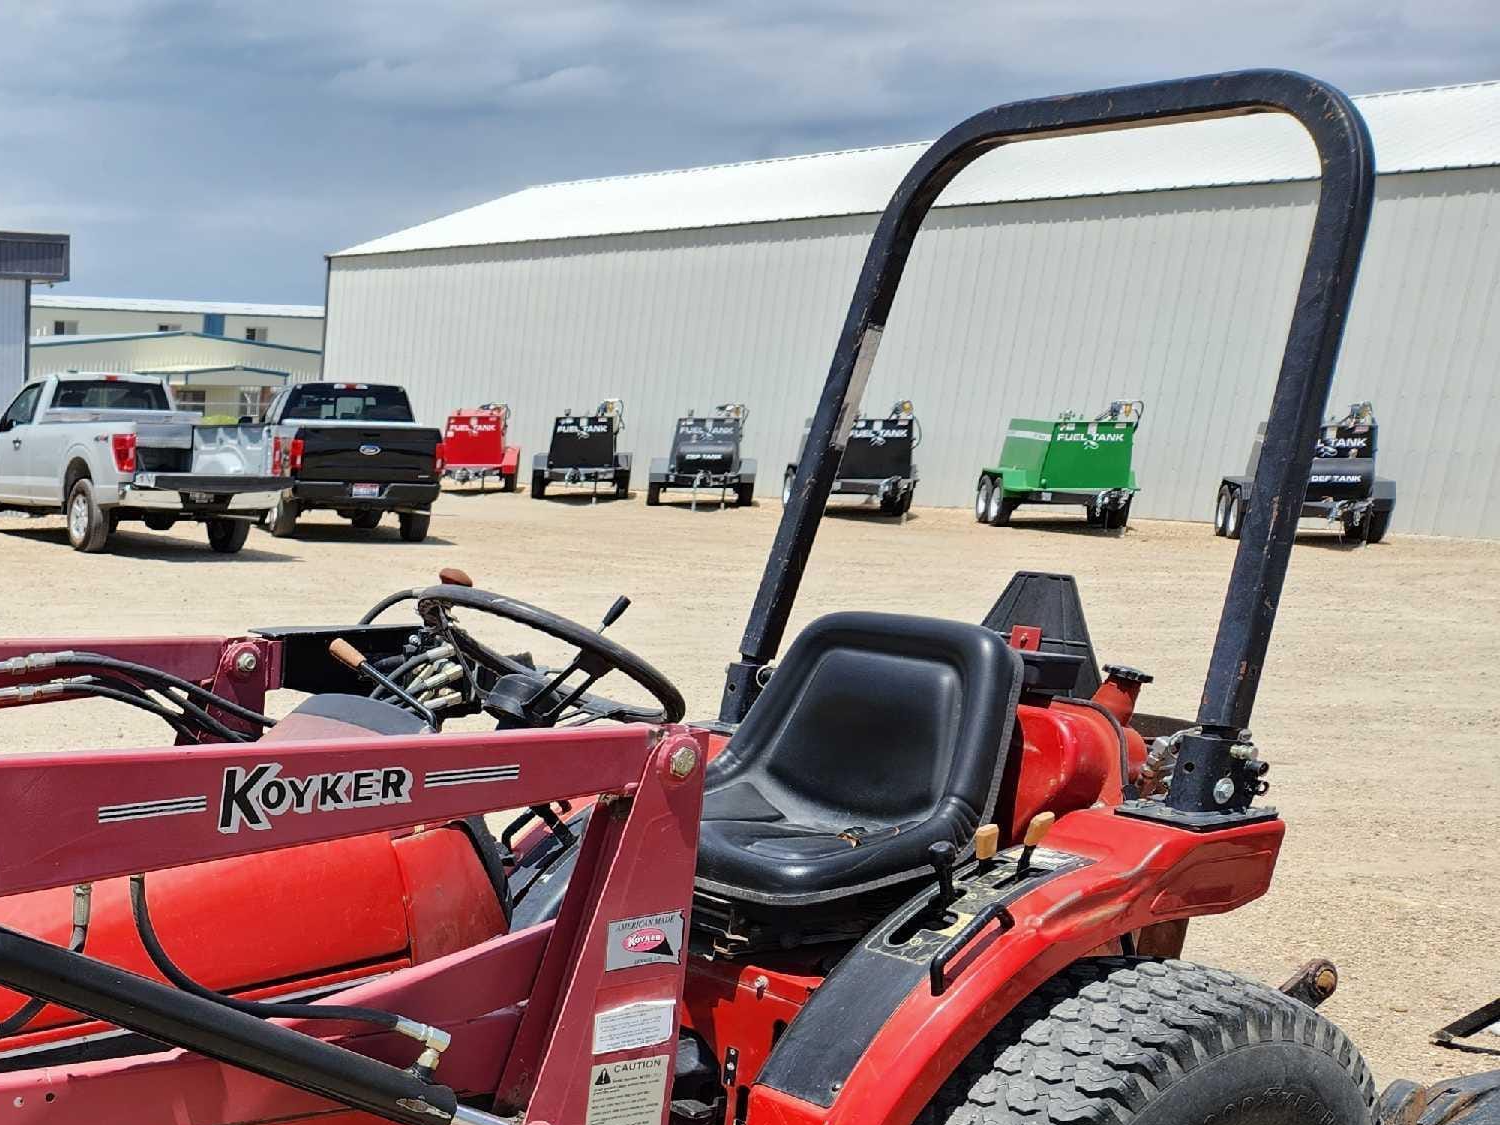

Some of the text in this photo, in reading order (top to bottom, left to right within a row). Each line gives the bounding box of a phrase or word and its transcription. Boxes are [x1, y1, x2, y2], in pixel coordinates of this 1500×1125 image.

[449, 424, 496, 432] FUEL TANK
[557, 425, 607, 433] FUEL TANK
[880, 429, 908, 437] TANK
[1092, 433, 1124, 441] TANK
[1330, 438, 1367, 447] TANK
[218, 762, 414, 834] KOYKER
[614, 1059, 661, 1074] CAUTION
